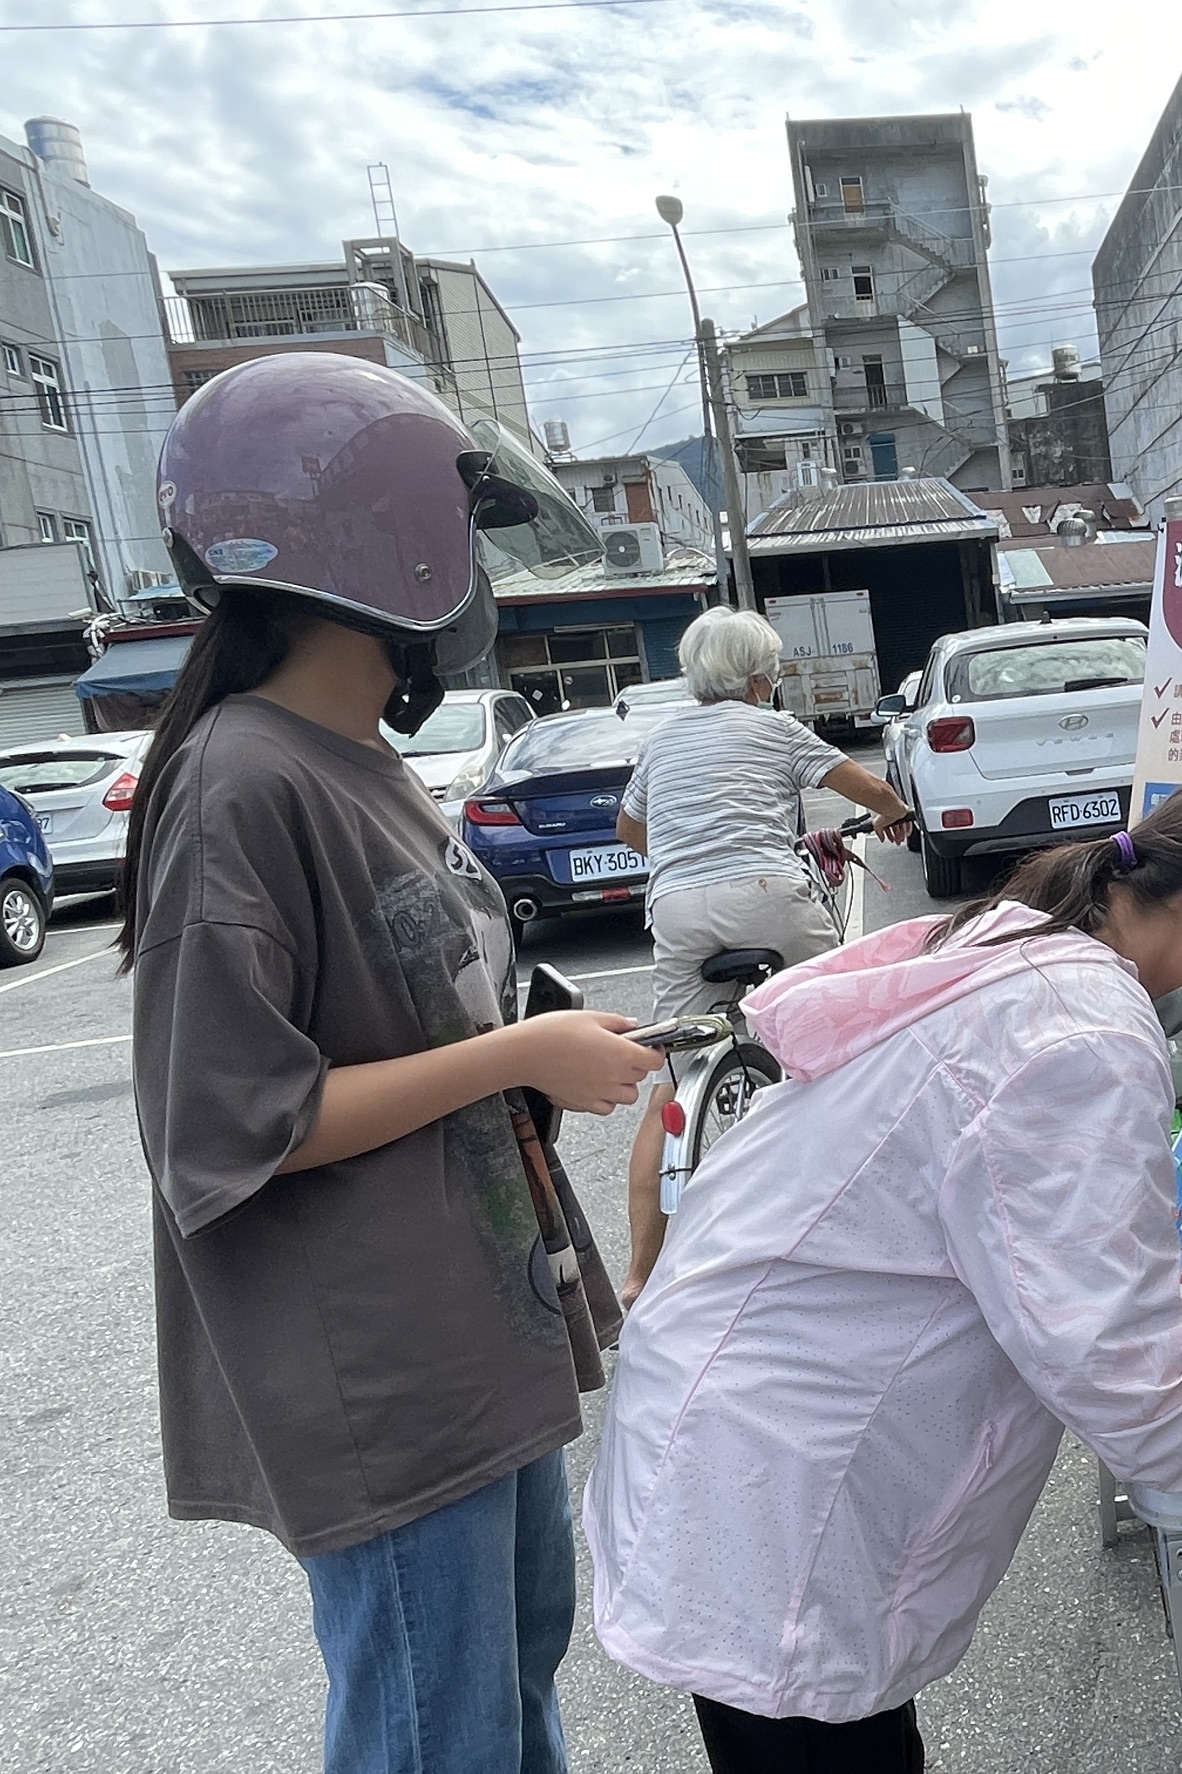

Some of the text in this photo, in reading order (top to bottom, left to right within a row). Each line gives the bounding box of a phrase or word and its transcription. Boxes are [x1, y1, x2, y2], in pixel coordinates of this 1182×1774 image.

[793, 642, 854, 657] ASJ 1186
[1051, 798, 1119, 824] RFD-6302
